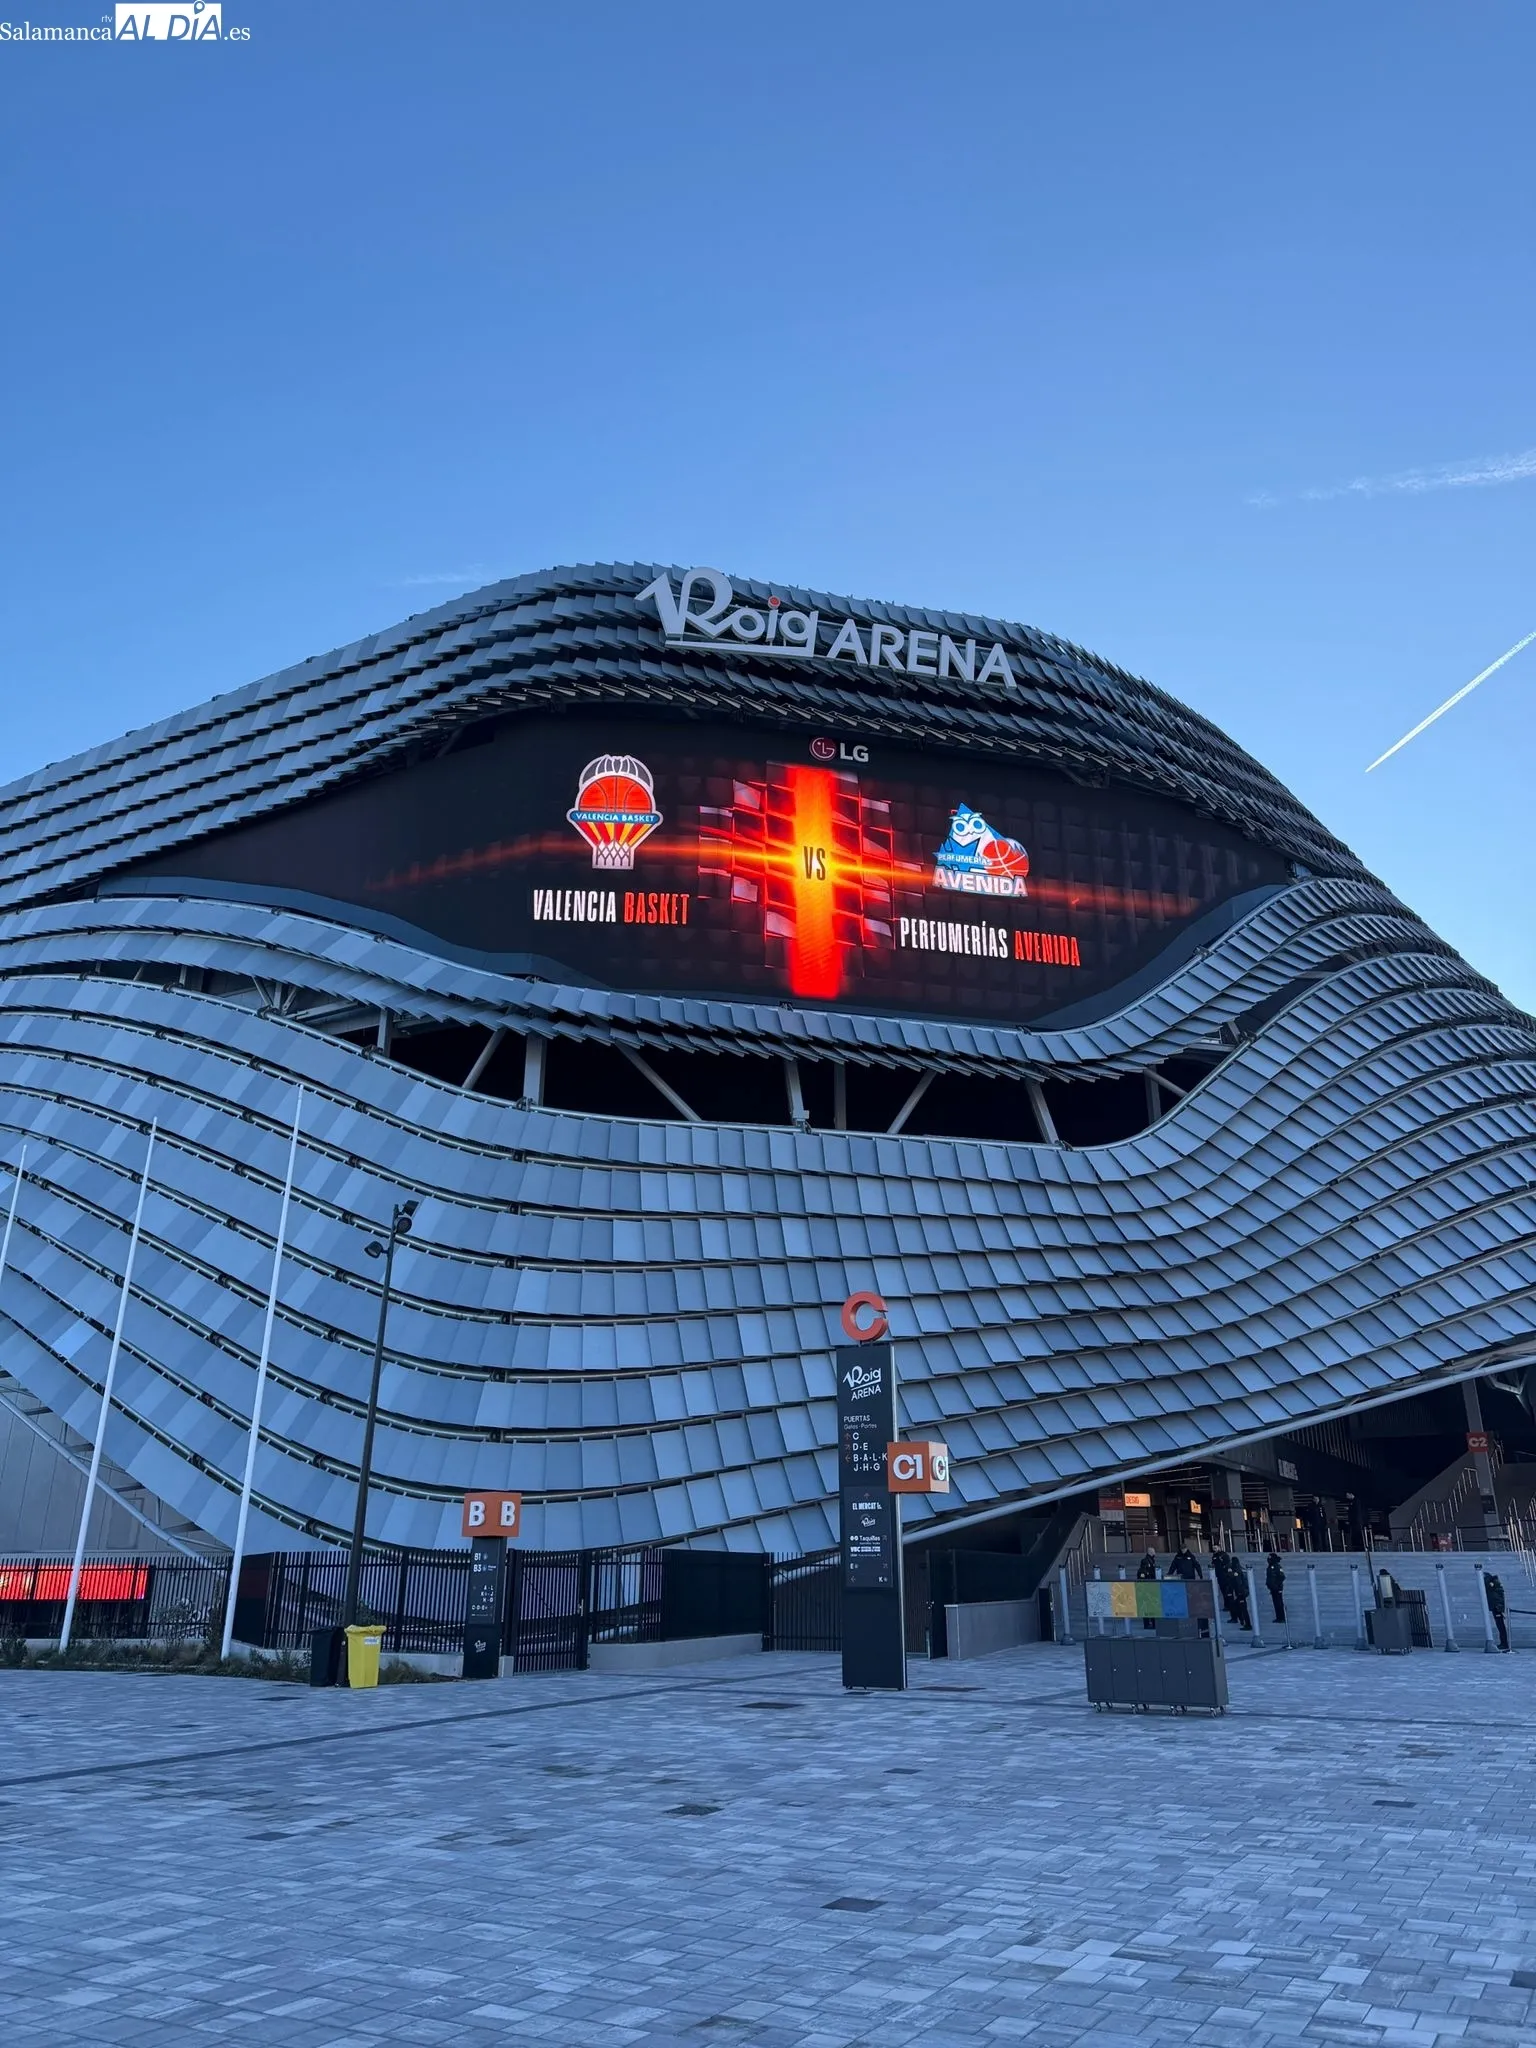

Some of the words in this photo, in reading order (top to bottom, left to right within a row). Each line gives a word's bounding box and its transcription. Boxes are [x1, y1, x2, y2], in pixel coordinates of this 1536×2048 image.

[634, 566, 819, 658] Roig
[825, 618, 1018, 689] ARENA
[839, 742, 870, 763] LG
[574, 811, 619, 822] VALENCIA
[621, 812, 656, 823] BASKET
[803, 845, 827, 881] VS
[932, 866, 1029, 898] AVENIDA
[532, 889, 618, 924] VALENCIA
[624, 891, 690, 926] BASKET
[900, 916, 1009, 959] PERFUMERÍAS
[1013, 929, 1082, 967] AVENIDA
[841, 1291, 889, 1342] C
[842, 1365, 882, 1391] Roig
[850, 1385, 882, 1402] ARENA
[843, 1414, 871, 1423] PUERTAS
[852, 1431, 860, 1441] C
[1467, 1436, 1488, 1448] C2
[892, 1453, 924, 1481] C1
[468, 1500, 486, 1528] B
[500, 1500, 517, 1527] B
